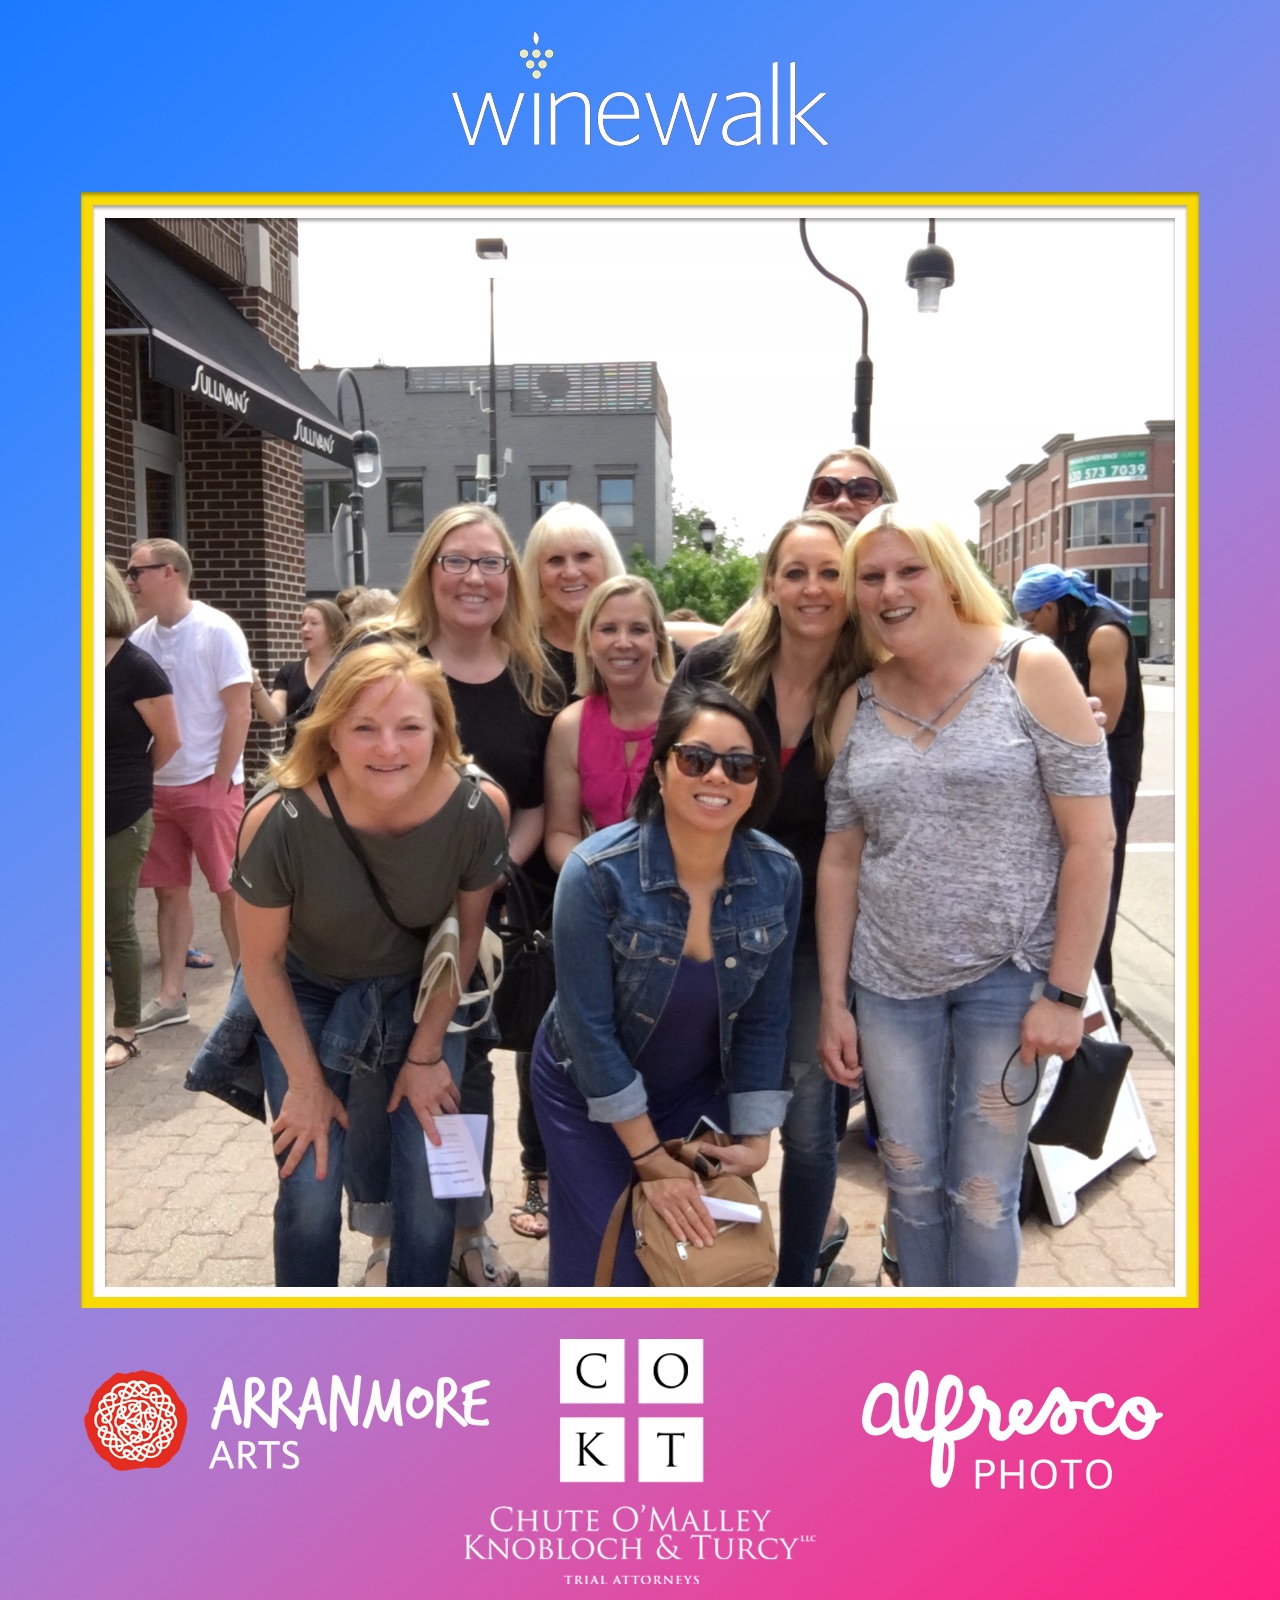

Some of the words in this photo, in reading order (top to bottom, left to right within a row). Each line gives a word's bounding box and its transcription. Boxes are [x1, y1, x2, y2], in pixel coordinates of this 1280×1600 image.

[191, 364, 250, 414] SULLIVAN'S
[1085, 467, 1106, 479] 573
[1111, 463, 1146, 476] 7039
